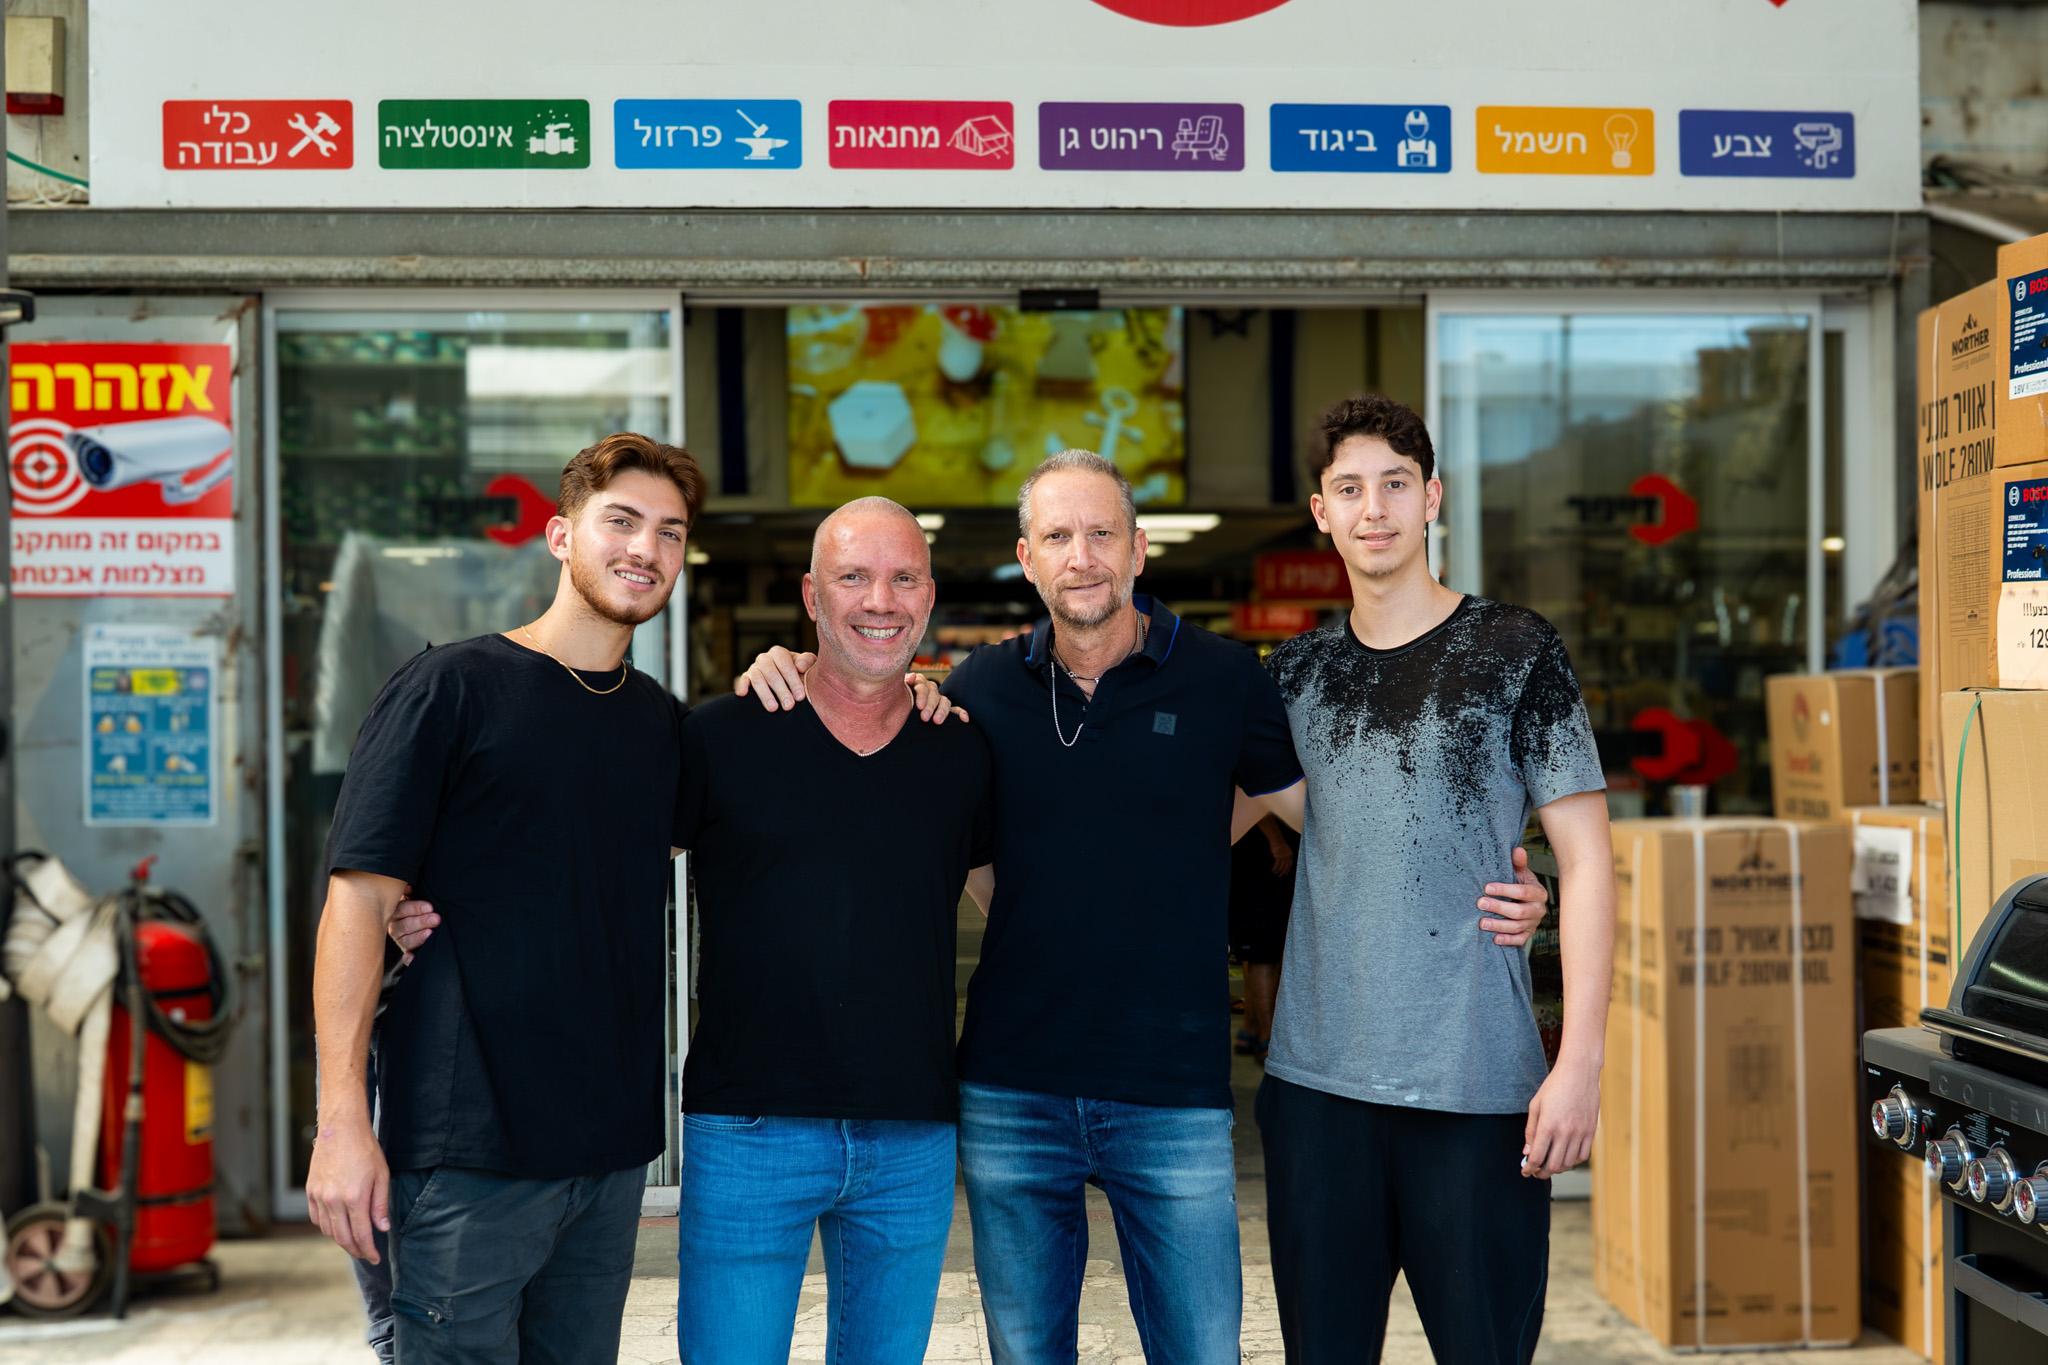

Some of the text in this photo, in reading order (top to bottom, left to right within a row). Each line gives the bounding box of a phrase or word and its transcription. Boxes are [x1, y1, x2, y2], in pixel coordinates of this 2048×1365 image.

[203, 104, 251, 135] כלי
[633, 118, 723, 148] פרזול
[385, 118, 514, 149] אינסטלציה
[834, 125, 940, 149] מחנאות
[1059, 127, 1163, 157] ריהוט גן
[1298, 129, 1378, 152] ביגוד
[1494, 124, 1588, 155] חשמל
[1711, 134, 1772, 158] צבע
[178, 141, 278, 166] עבודה
[1951, 327, 1989, 357] NORTHER
[10, 362, 215, 412] אזהרה
[1953, 383, 1986, 435] אוויר
[1922, 436, 1996, 492] WOLF 280W
[100, 531, 129, 552] זה
[136, 531, 221, 555] במקום
[102, 560, 207, 585] מצלמות
[2006, 567, 2042, 579] Professional
[1710, 874, 1804, 892] NORTHE
